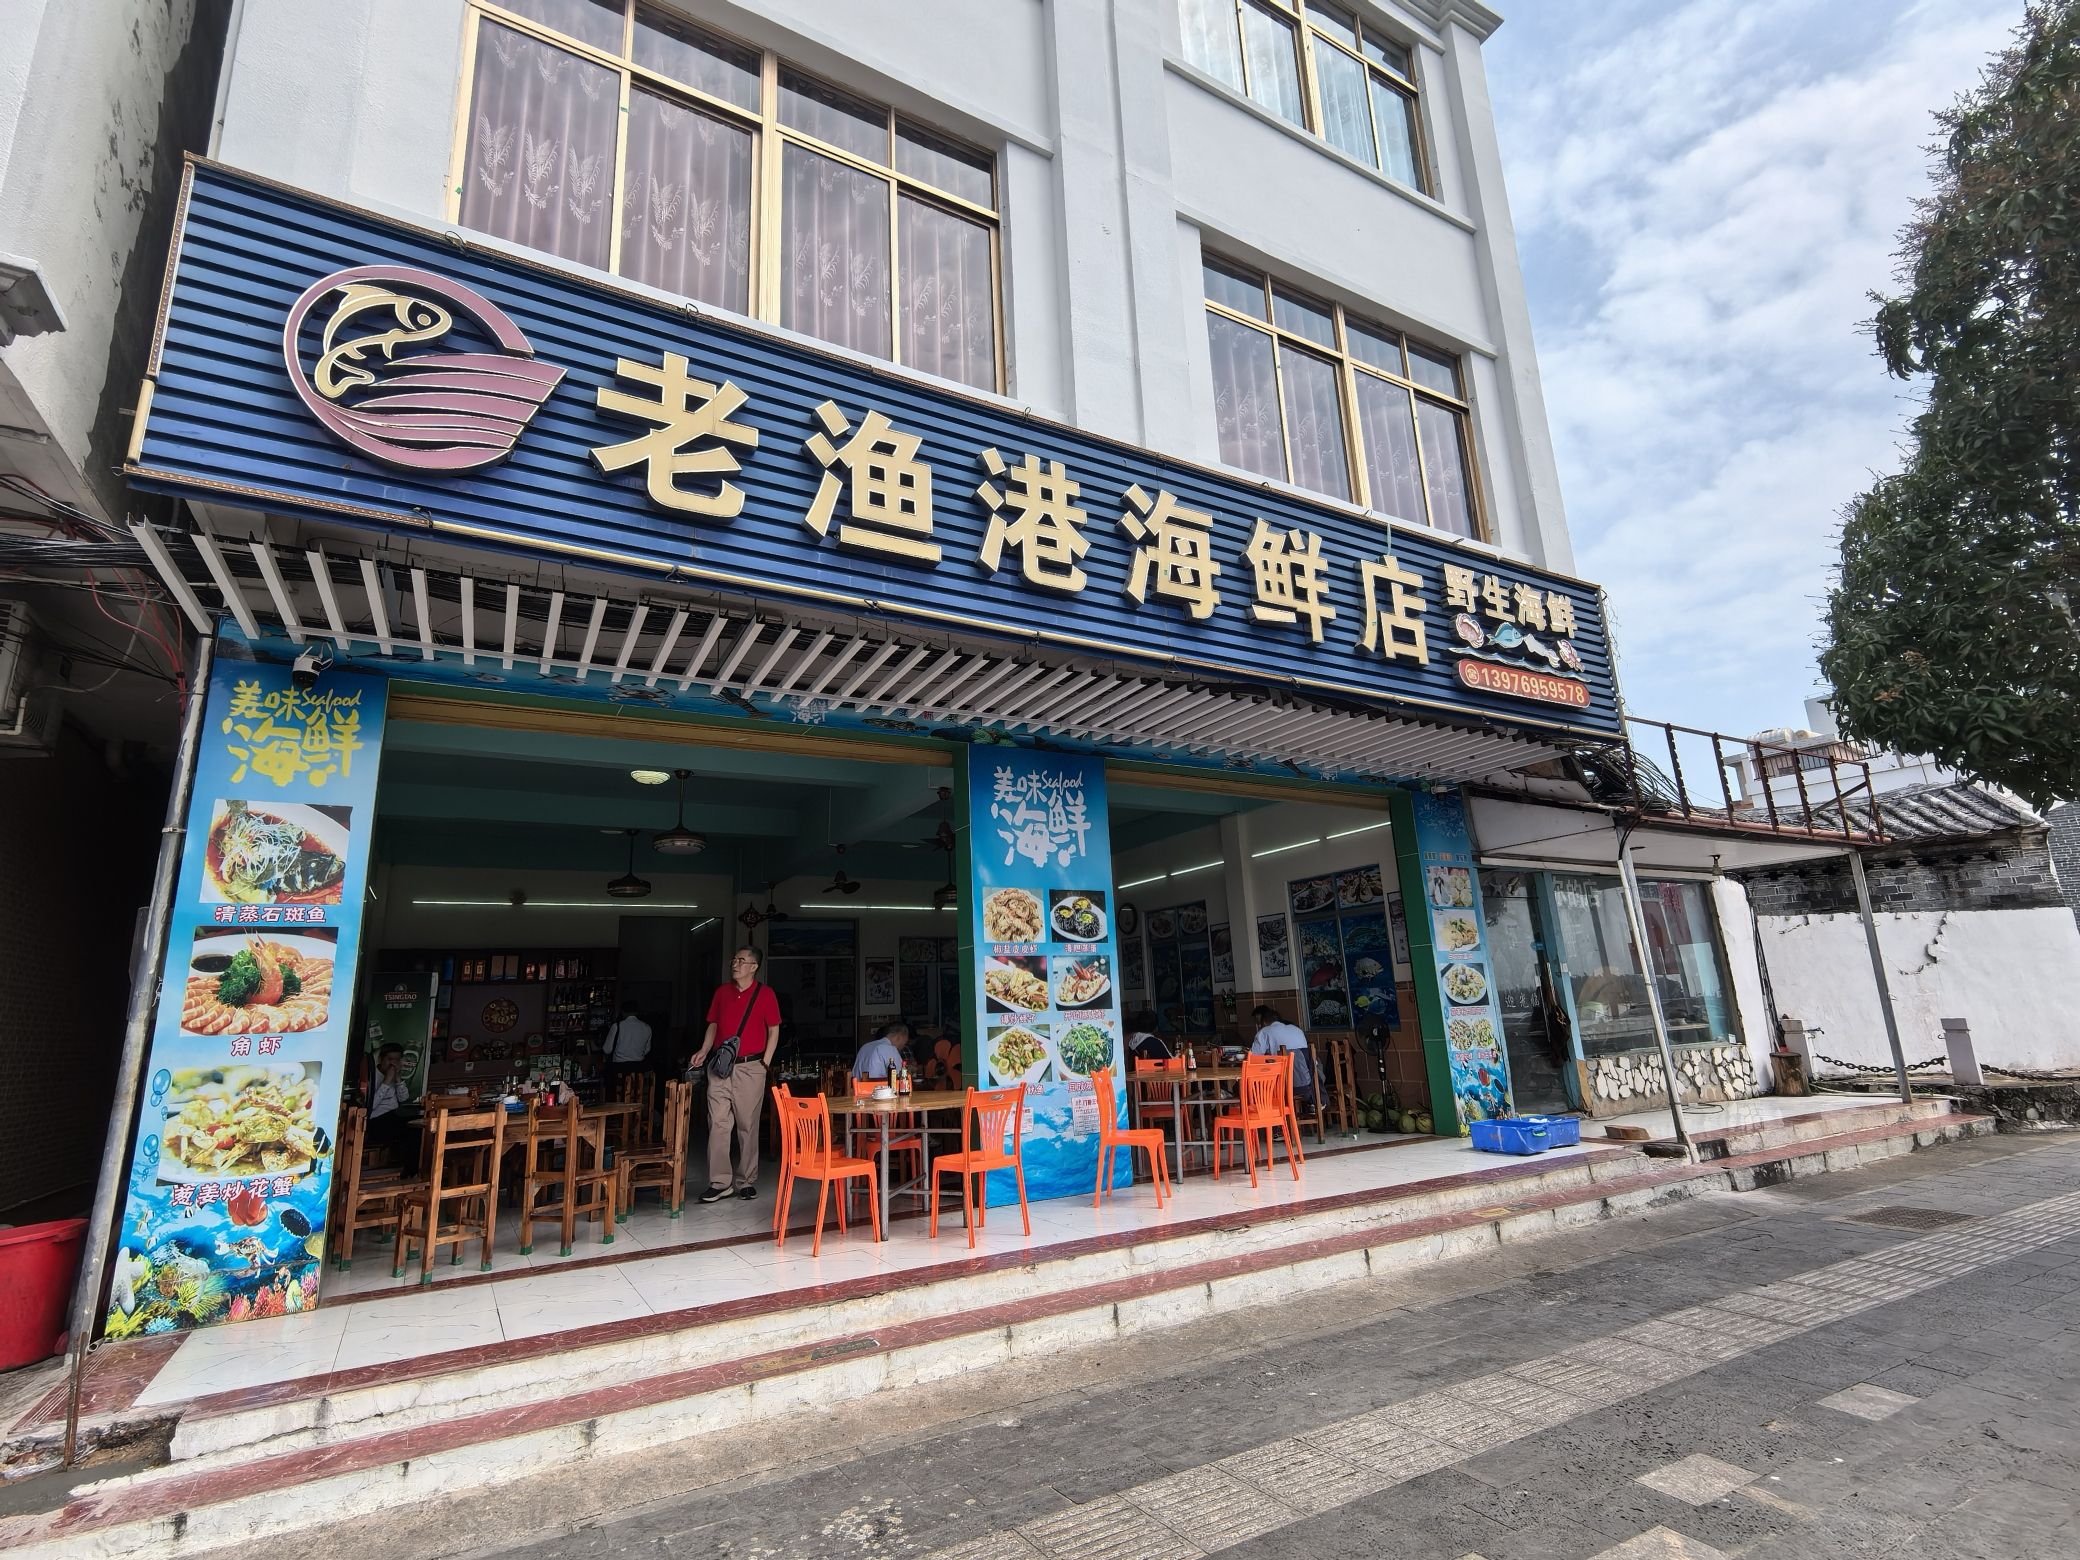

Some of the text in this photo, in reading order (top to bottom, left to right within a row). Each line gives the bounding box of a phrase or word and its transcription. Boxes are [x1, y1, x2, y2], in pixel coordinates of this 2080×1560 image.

[589, 351, 1429, 666] 老渔港海鲜店
[1443, 563, 1578, 639] 野生海鲜
[230, 680, 304, 721] 美味
[301, 688, 363, 715] Seafood
[1481, 668, 1585, 704] 13976959578
[222, 709, 364, 788] 海鲜
[994, 766, 1046, 804] 美味
[1042, 770, 1083, 795] Seafood
[991, 790, 1091, 868] 海鲜
[214, 905, 327, 924] 清蒸石斑鱼
[231, 1036, 283, 1057] 角虾
[171, 1176, 295, 1207] 葱姜炒花蟹
